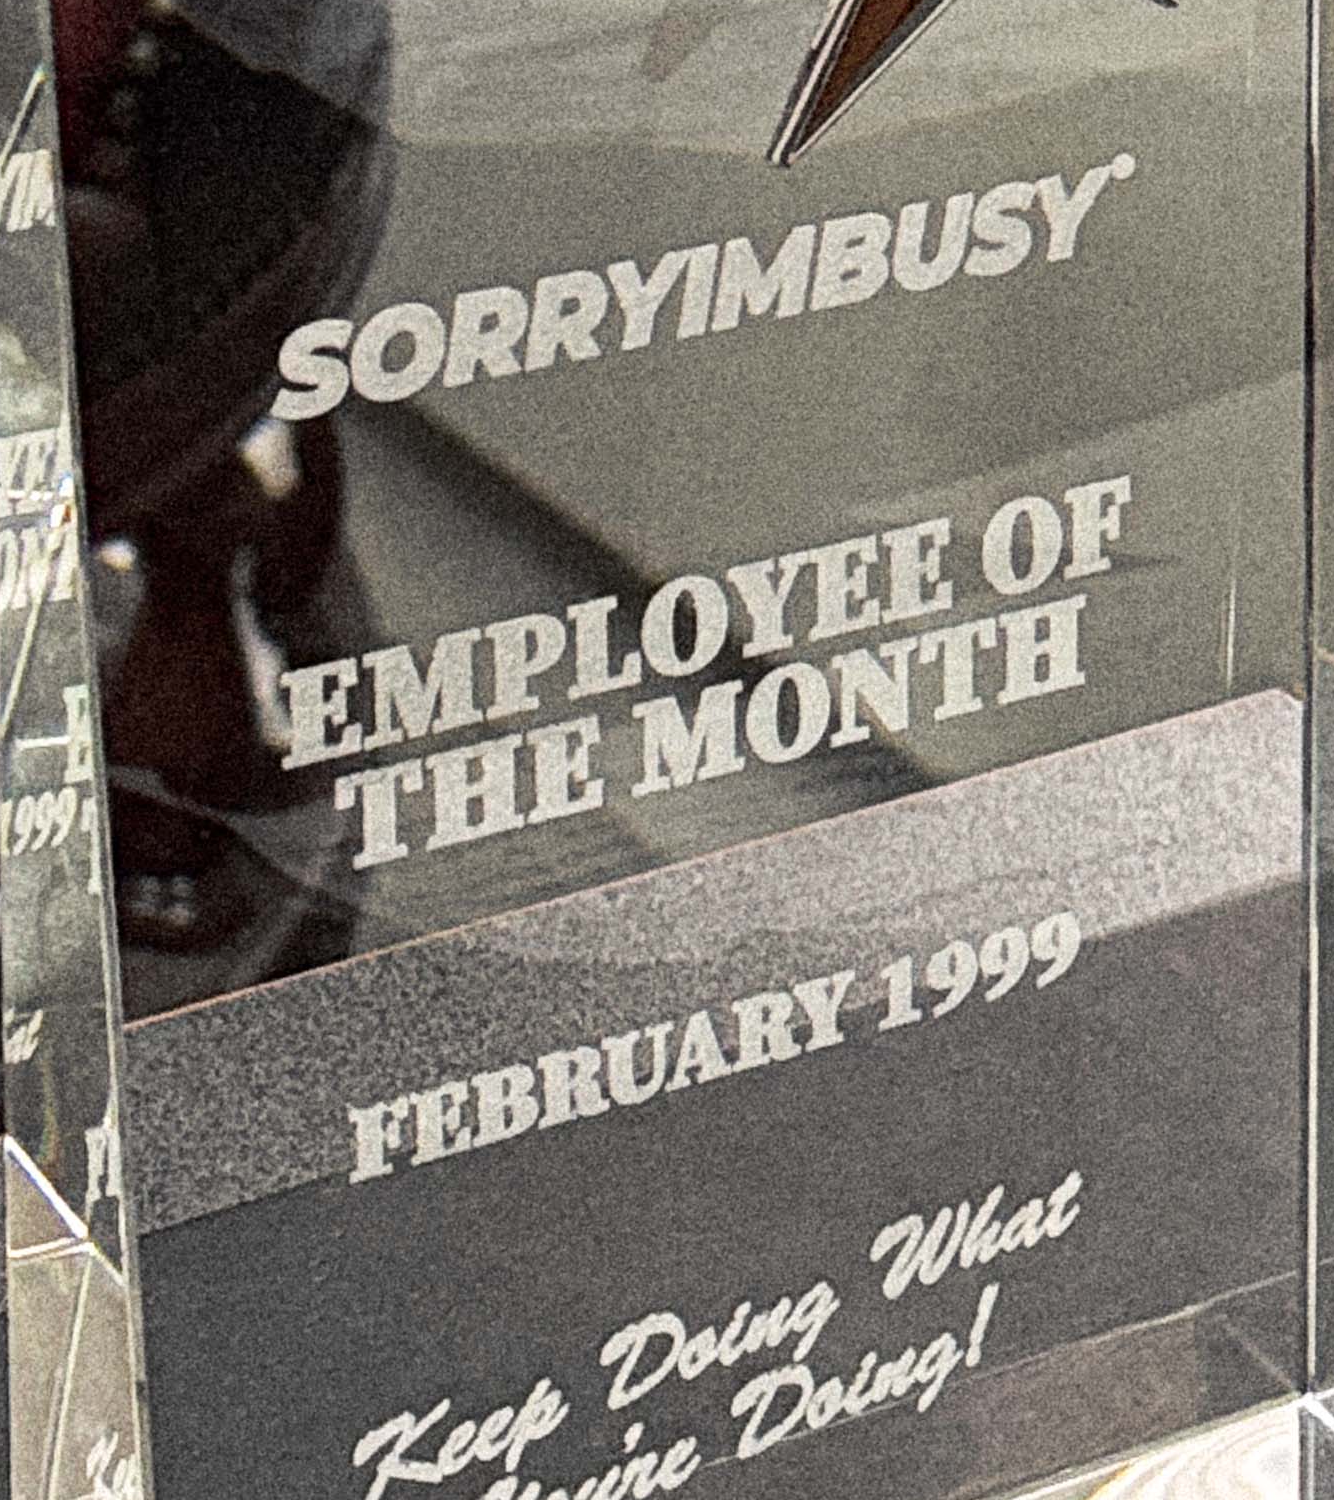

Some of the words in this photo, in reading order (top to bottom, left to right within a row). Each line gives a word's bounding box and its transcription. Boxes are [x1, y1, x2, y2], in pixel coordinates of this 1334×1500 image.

[269, 156, 1125, 421] SORRYIMBUSY
[279, 515, 954, 771] EMPLOYEE
[980, 474, 1132, 597] OF
[334, 714, 605, 871] THE
[630, 593, 1088, 800] MONTH
[348, 968, 857, 1185] FEBRUARY
[877, 911, 1084, 1031] 1999
[599, 1279, 841, 1412] Doing
[869, 1169, 1084, 1300] What
[731, 1283, 1000, 1459] Doing!
